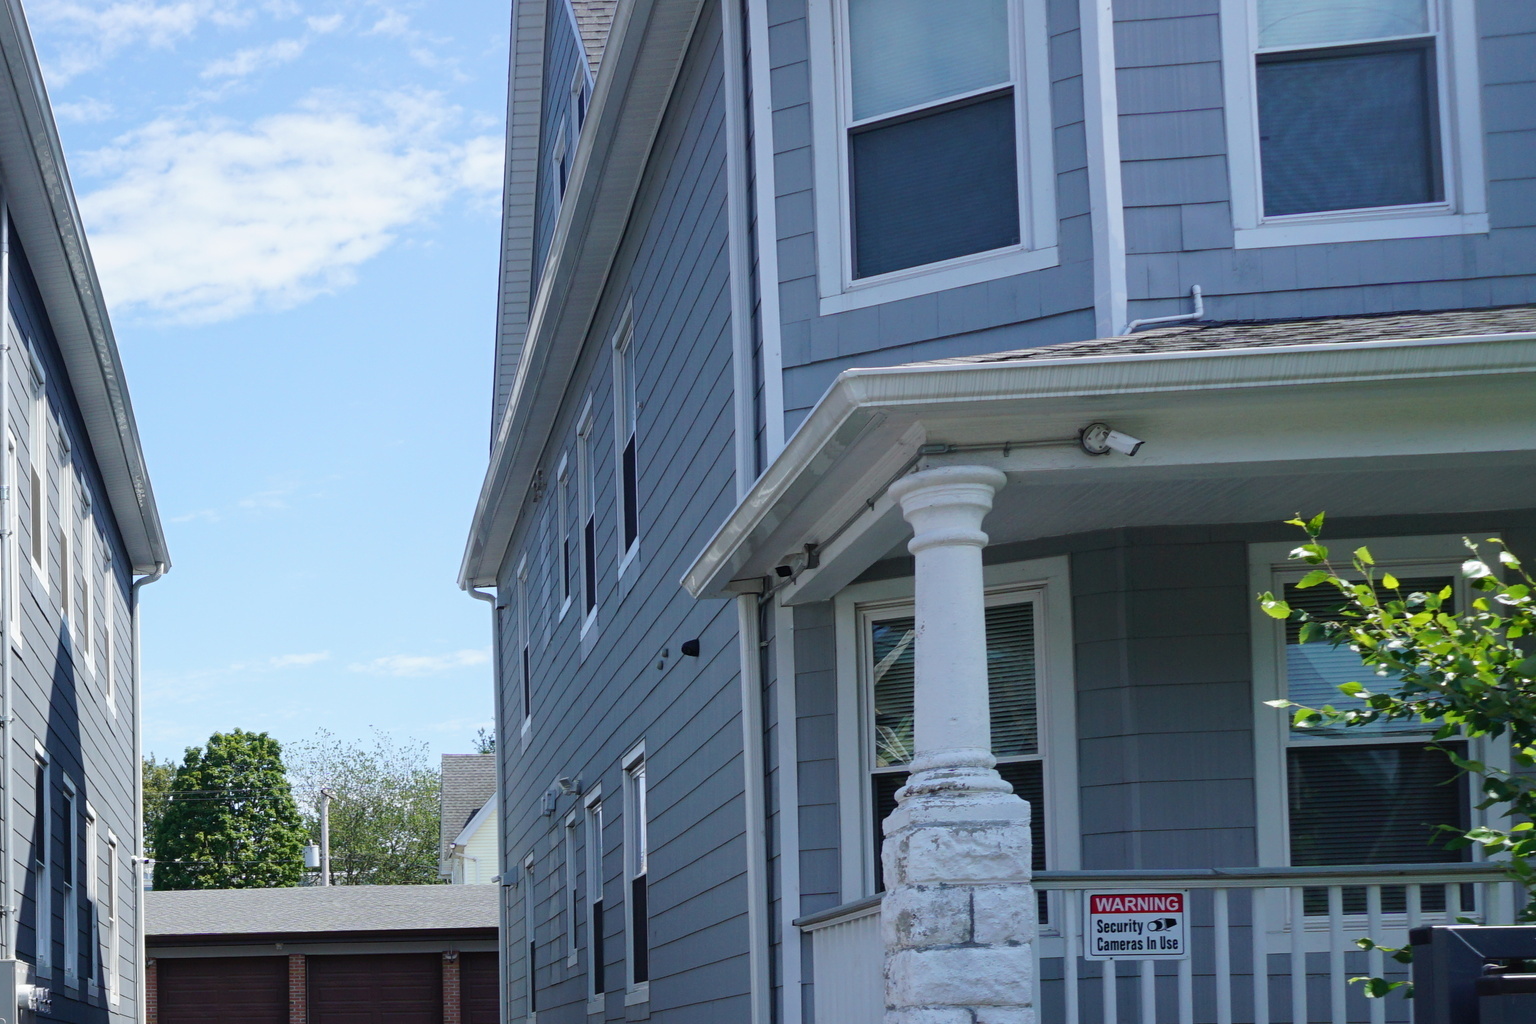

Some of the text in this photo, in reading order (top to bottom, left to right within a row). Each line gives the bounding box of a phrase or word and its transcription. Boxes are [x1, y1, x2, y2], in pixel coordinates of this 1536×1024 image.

[1095, 896, 1179, 912] WARNING
[1097, 919, 1143, 935] Security
[1097, 936, 1178, 951] Cameras In Use
